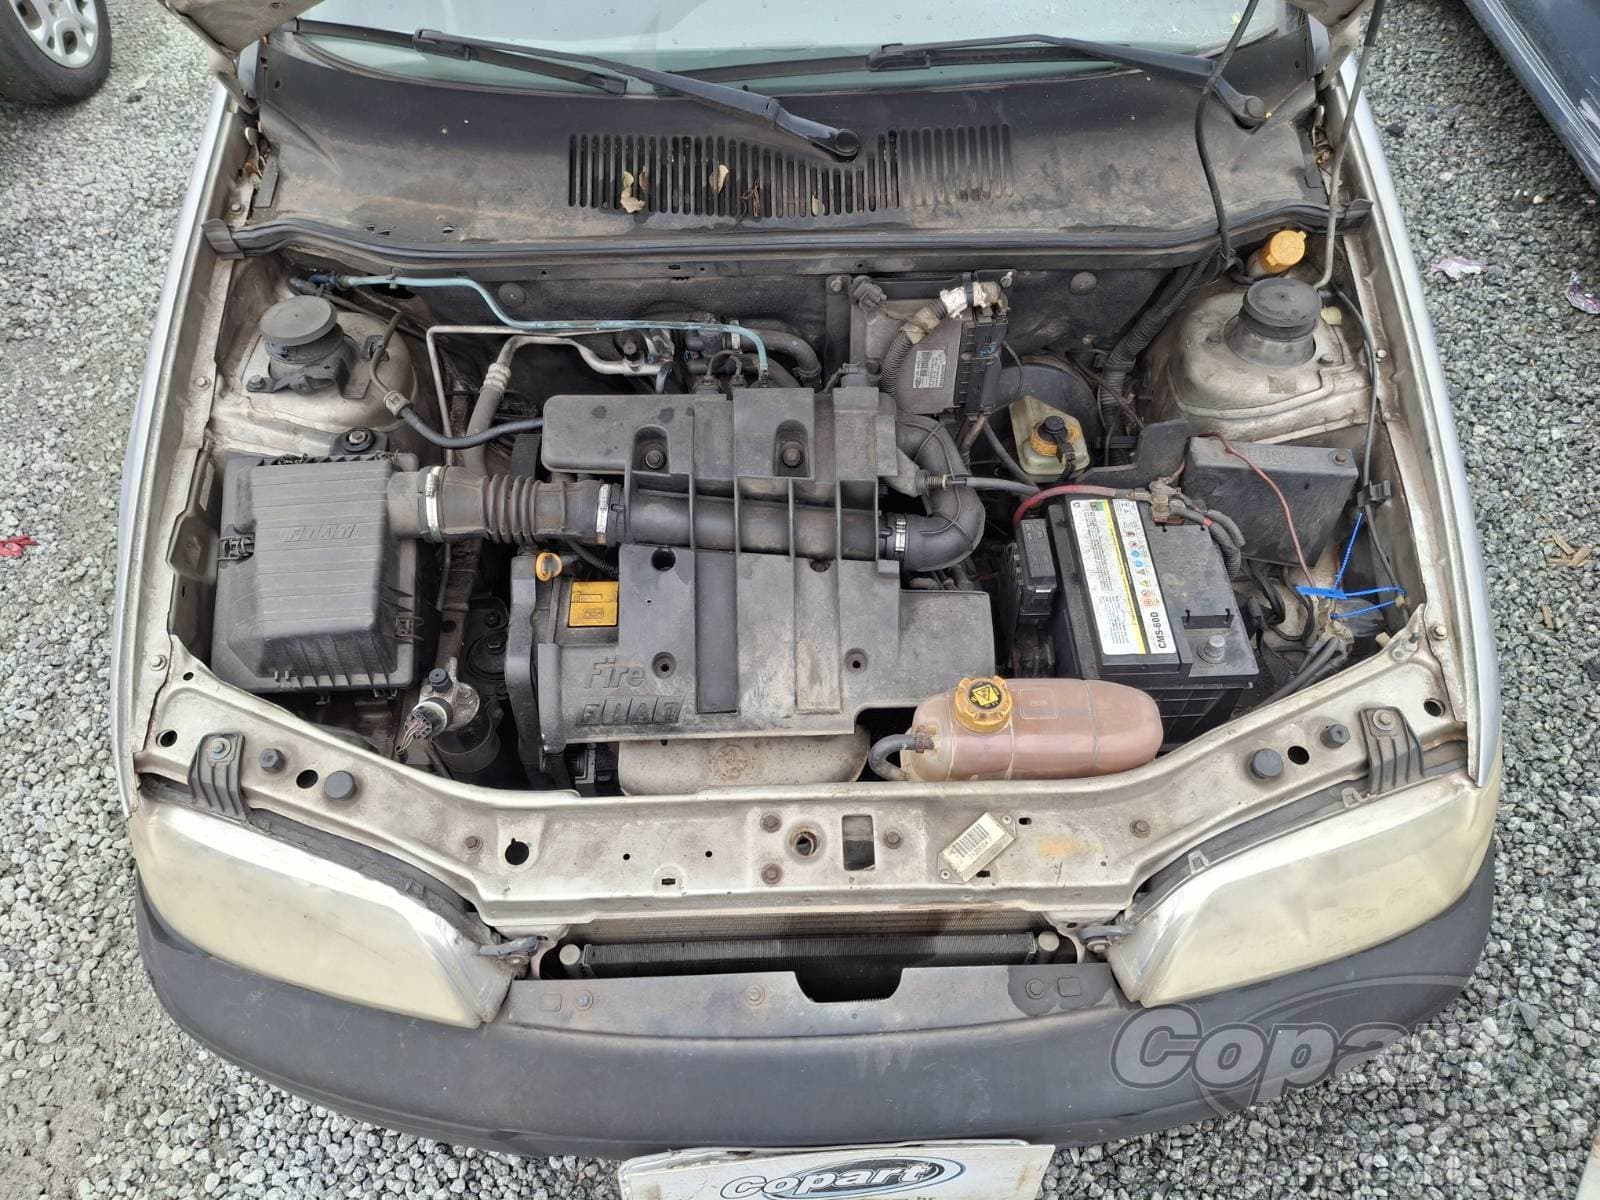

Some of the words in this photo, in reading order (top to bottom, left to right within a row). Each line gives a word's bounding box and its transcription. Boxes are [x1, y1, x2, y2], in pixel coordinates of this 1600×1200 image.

[283, 522, 357, 542] FIAT
[584, 655, 646, 690] Fire
[577, 696, 685, 725] FIAT
